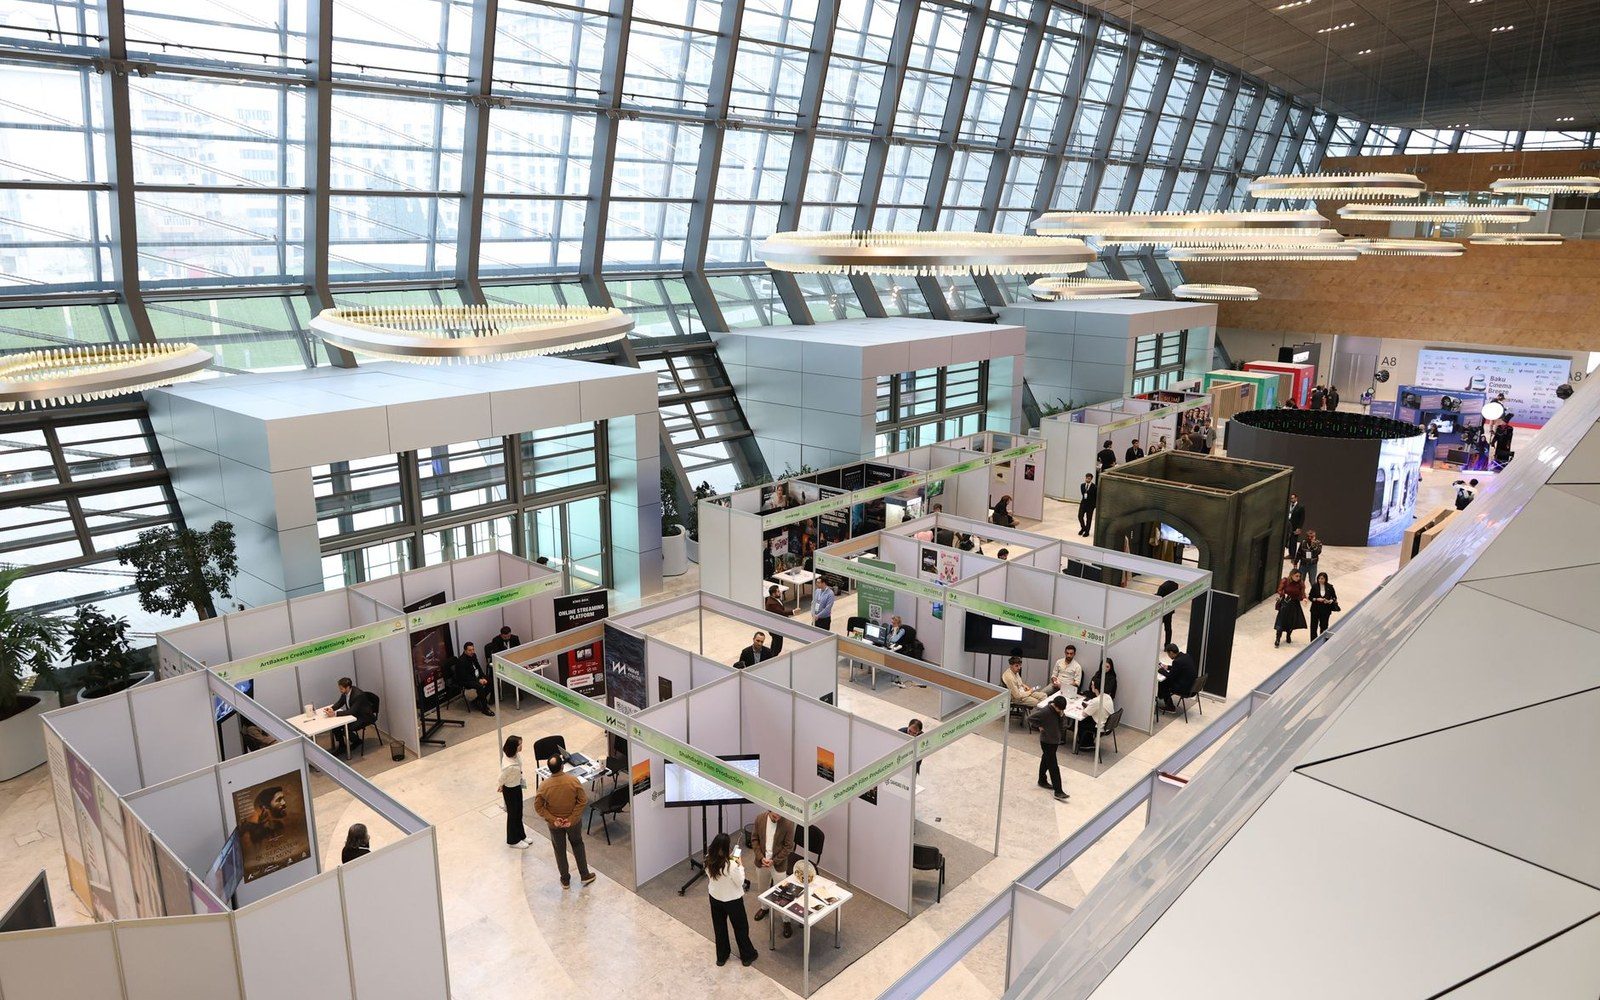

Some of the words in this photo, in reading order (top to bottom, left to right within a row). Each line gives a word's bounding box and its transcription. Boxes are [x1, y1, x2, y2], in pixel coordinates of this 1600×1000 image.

[1381, 356, 1397, 366] A8
[477, 596, 499, 606] Streaming
[500, 591, 519, 600] Platform
[558, 608, 576, 617] ONLINE
[577, 604, 605, 614] STREAMING
[569, 611, 595, 620] PLATFORM
[1016, 613, 1040, 623] Animation
[260, 655, 289, 668] ArtBakers
[290, 649, 313, 659] Creative
[314, 640, 345, 652] Advertising
[346, 633, 366, 644] Agency
[535, 682, 546, 691] Wave
[545, 687, 558, 697] Media
[558, 693, 580, 707] Production
[941, 726, 956, 739] Chinar
[956, 722, 966, 732] Film
[965, 712, 988, 728] Production
[678, 750, 703, 767] Shahdagh
[703, 761, 716, 772] Film
[715, 767, 744, 786] Production
[833, 781, 859, 800] Shahdagh
[858, 776, 869, 787] Film
[869, 761, 895, 779] Production
